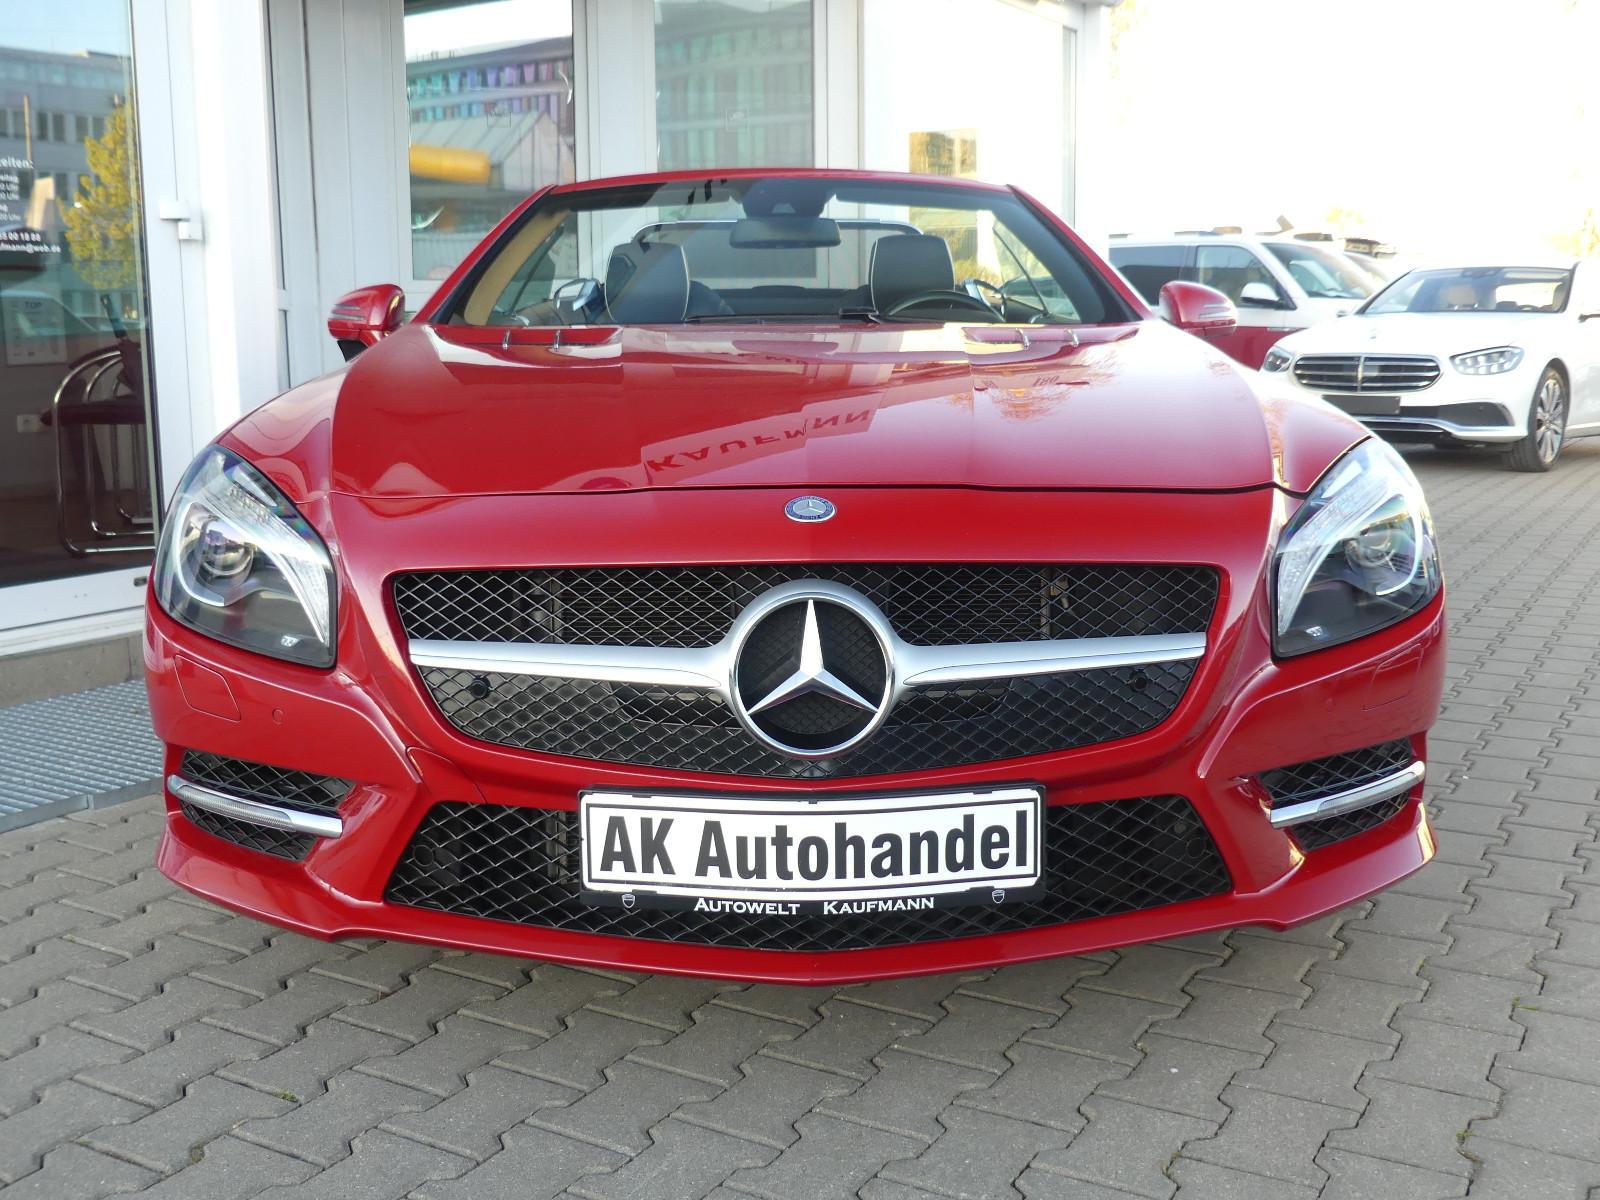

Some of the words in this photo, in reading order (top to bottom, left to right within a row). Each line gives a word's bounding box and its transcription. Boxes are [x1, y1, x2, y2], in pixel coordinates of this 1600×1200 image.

[0, 157, 34, 168] eiten:
[600, 815, 676, 874] AK
[694, 809, 1028, 881] Autohandel
[693, 896, 801, 915] AUTOWELT
[823, 896, 936, 915] KAUFMANN
